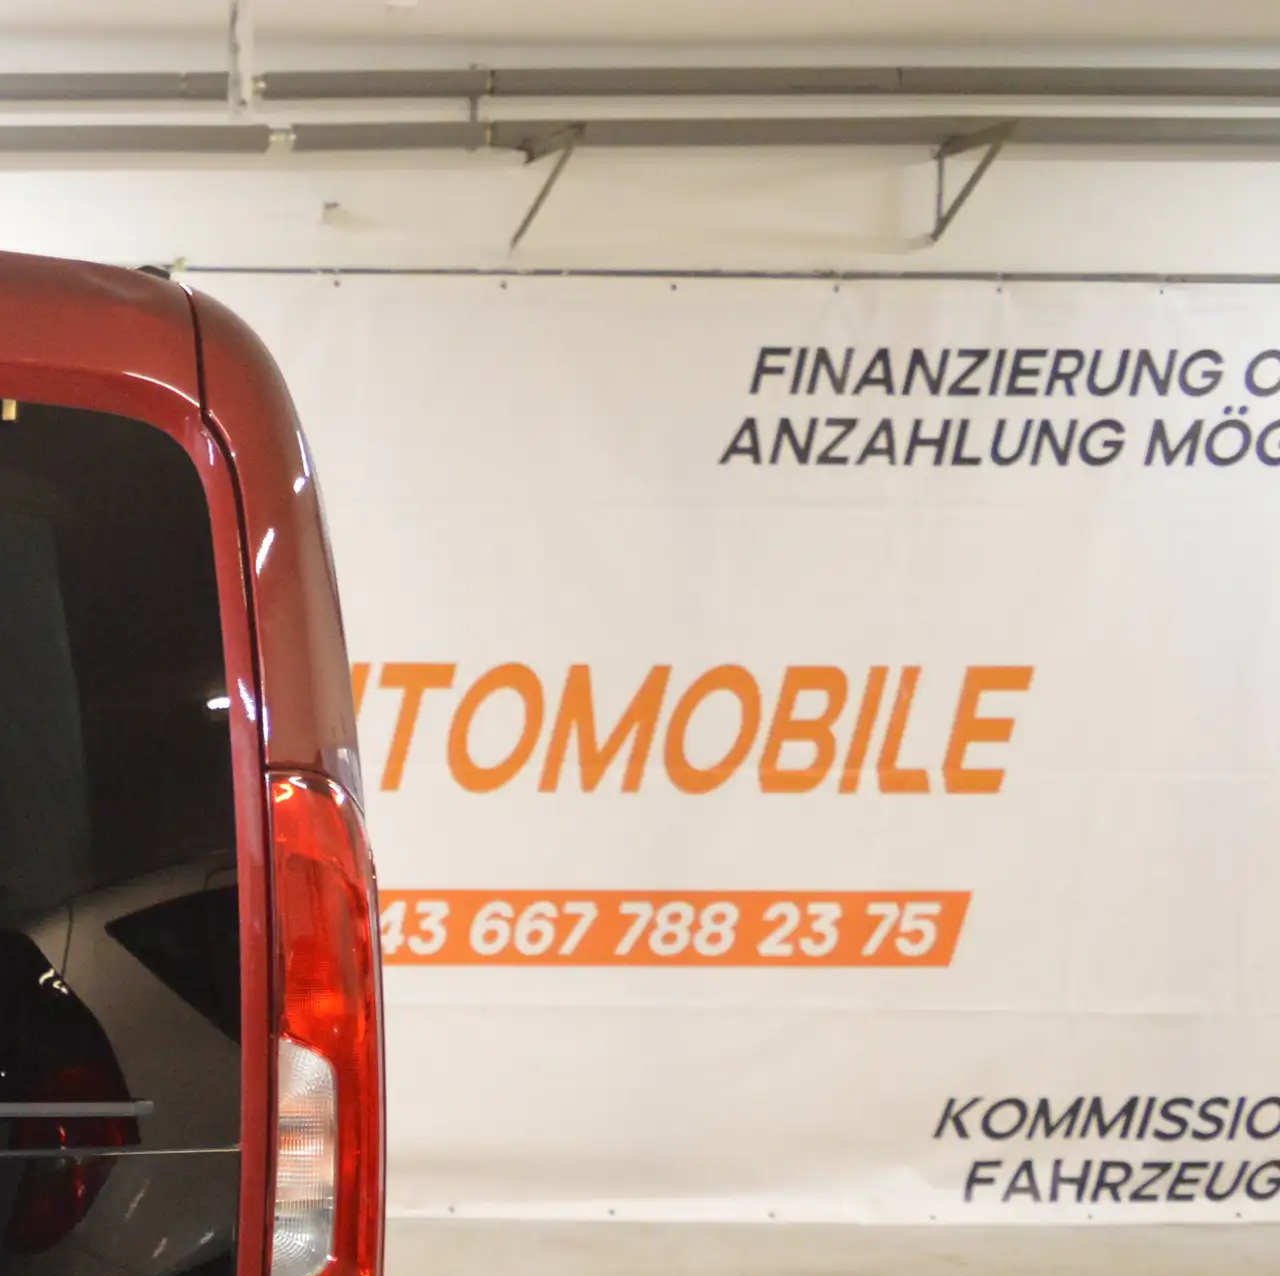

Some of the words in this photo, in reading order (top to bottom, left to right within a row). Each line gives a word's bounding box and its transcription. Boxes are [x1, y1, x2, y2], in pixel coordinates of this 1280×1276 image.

[748, 346, 1225, 398] FINANZIERUNG
[718, 416, 1126, 467] ANZAHLUNG
[468, 900, 597, 957] 667
[613, 901, 737, 957] 788
[756, 902, 840, 958] 23
[859, 902, 942, 958] 75
[933, 1096, 1280, 1141] KOMMISSIO
[963, 1158, 1280, 1202] FAHRZEUG
